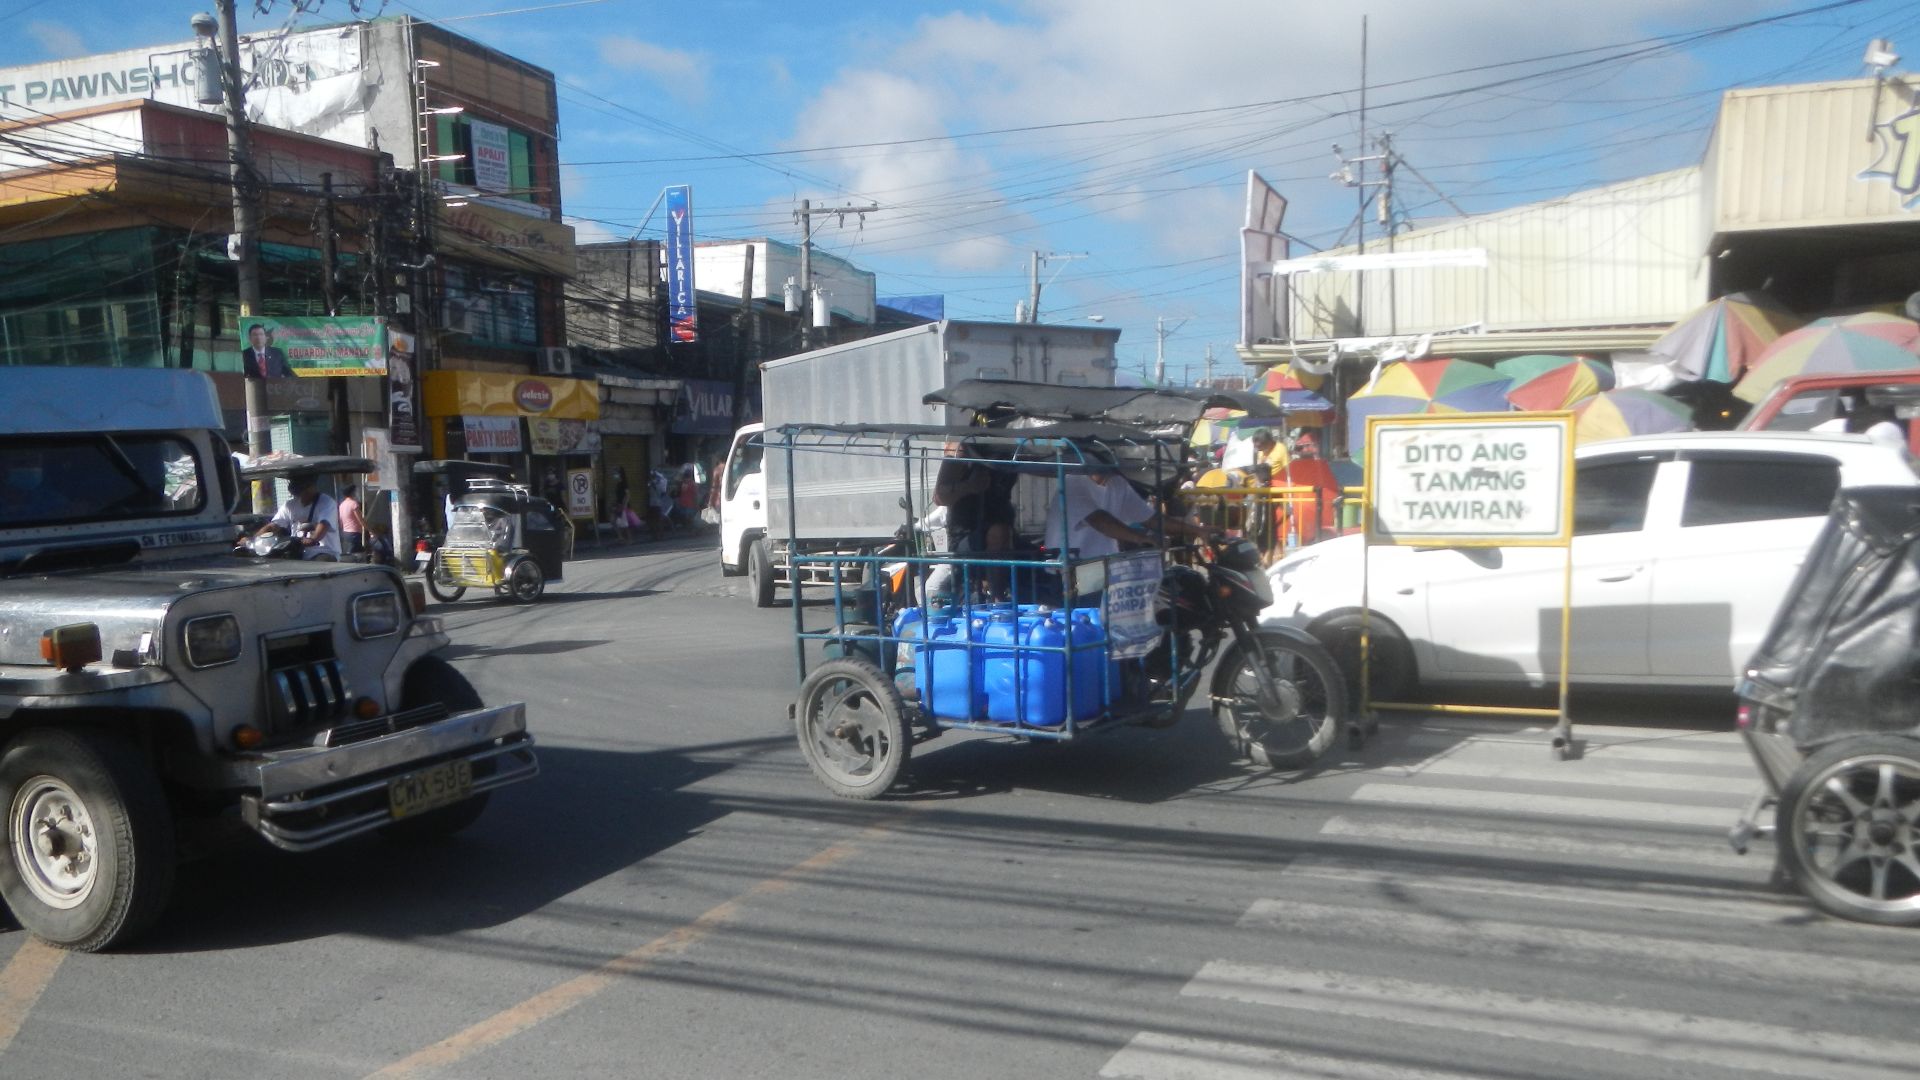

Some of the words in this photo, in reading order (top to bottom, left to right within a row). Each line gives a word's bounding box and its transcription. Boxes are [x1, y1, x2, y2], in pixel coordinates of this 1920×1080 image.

[25, 61, 197, 106] PAWNSHO
[672, 208, 687, 315] VILLARICA
[685, 385, 753, 421] VILLARA
[466, 430, 494, 447] PARTY
[495, 430, 519, 447] NEEDS
[1405, 444, 1463, 463] DITO
[1472, 442, 1526, 461] ANG
[1411, 470, 1526, 492] TAMANG
[1403, 500, 1525, 520] TAWIRAN
